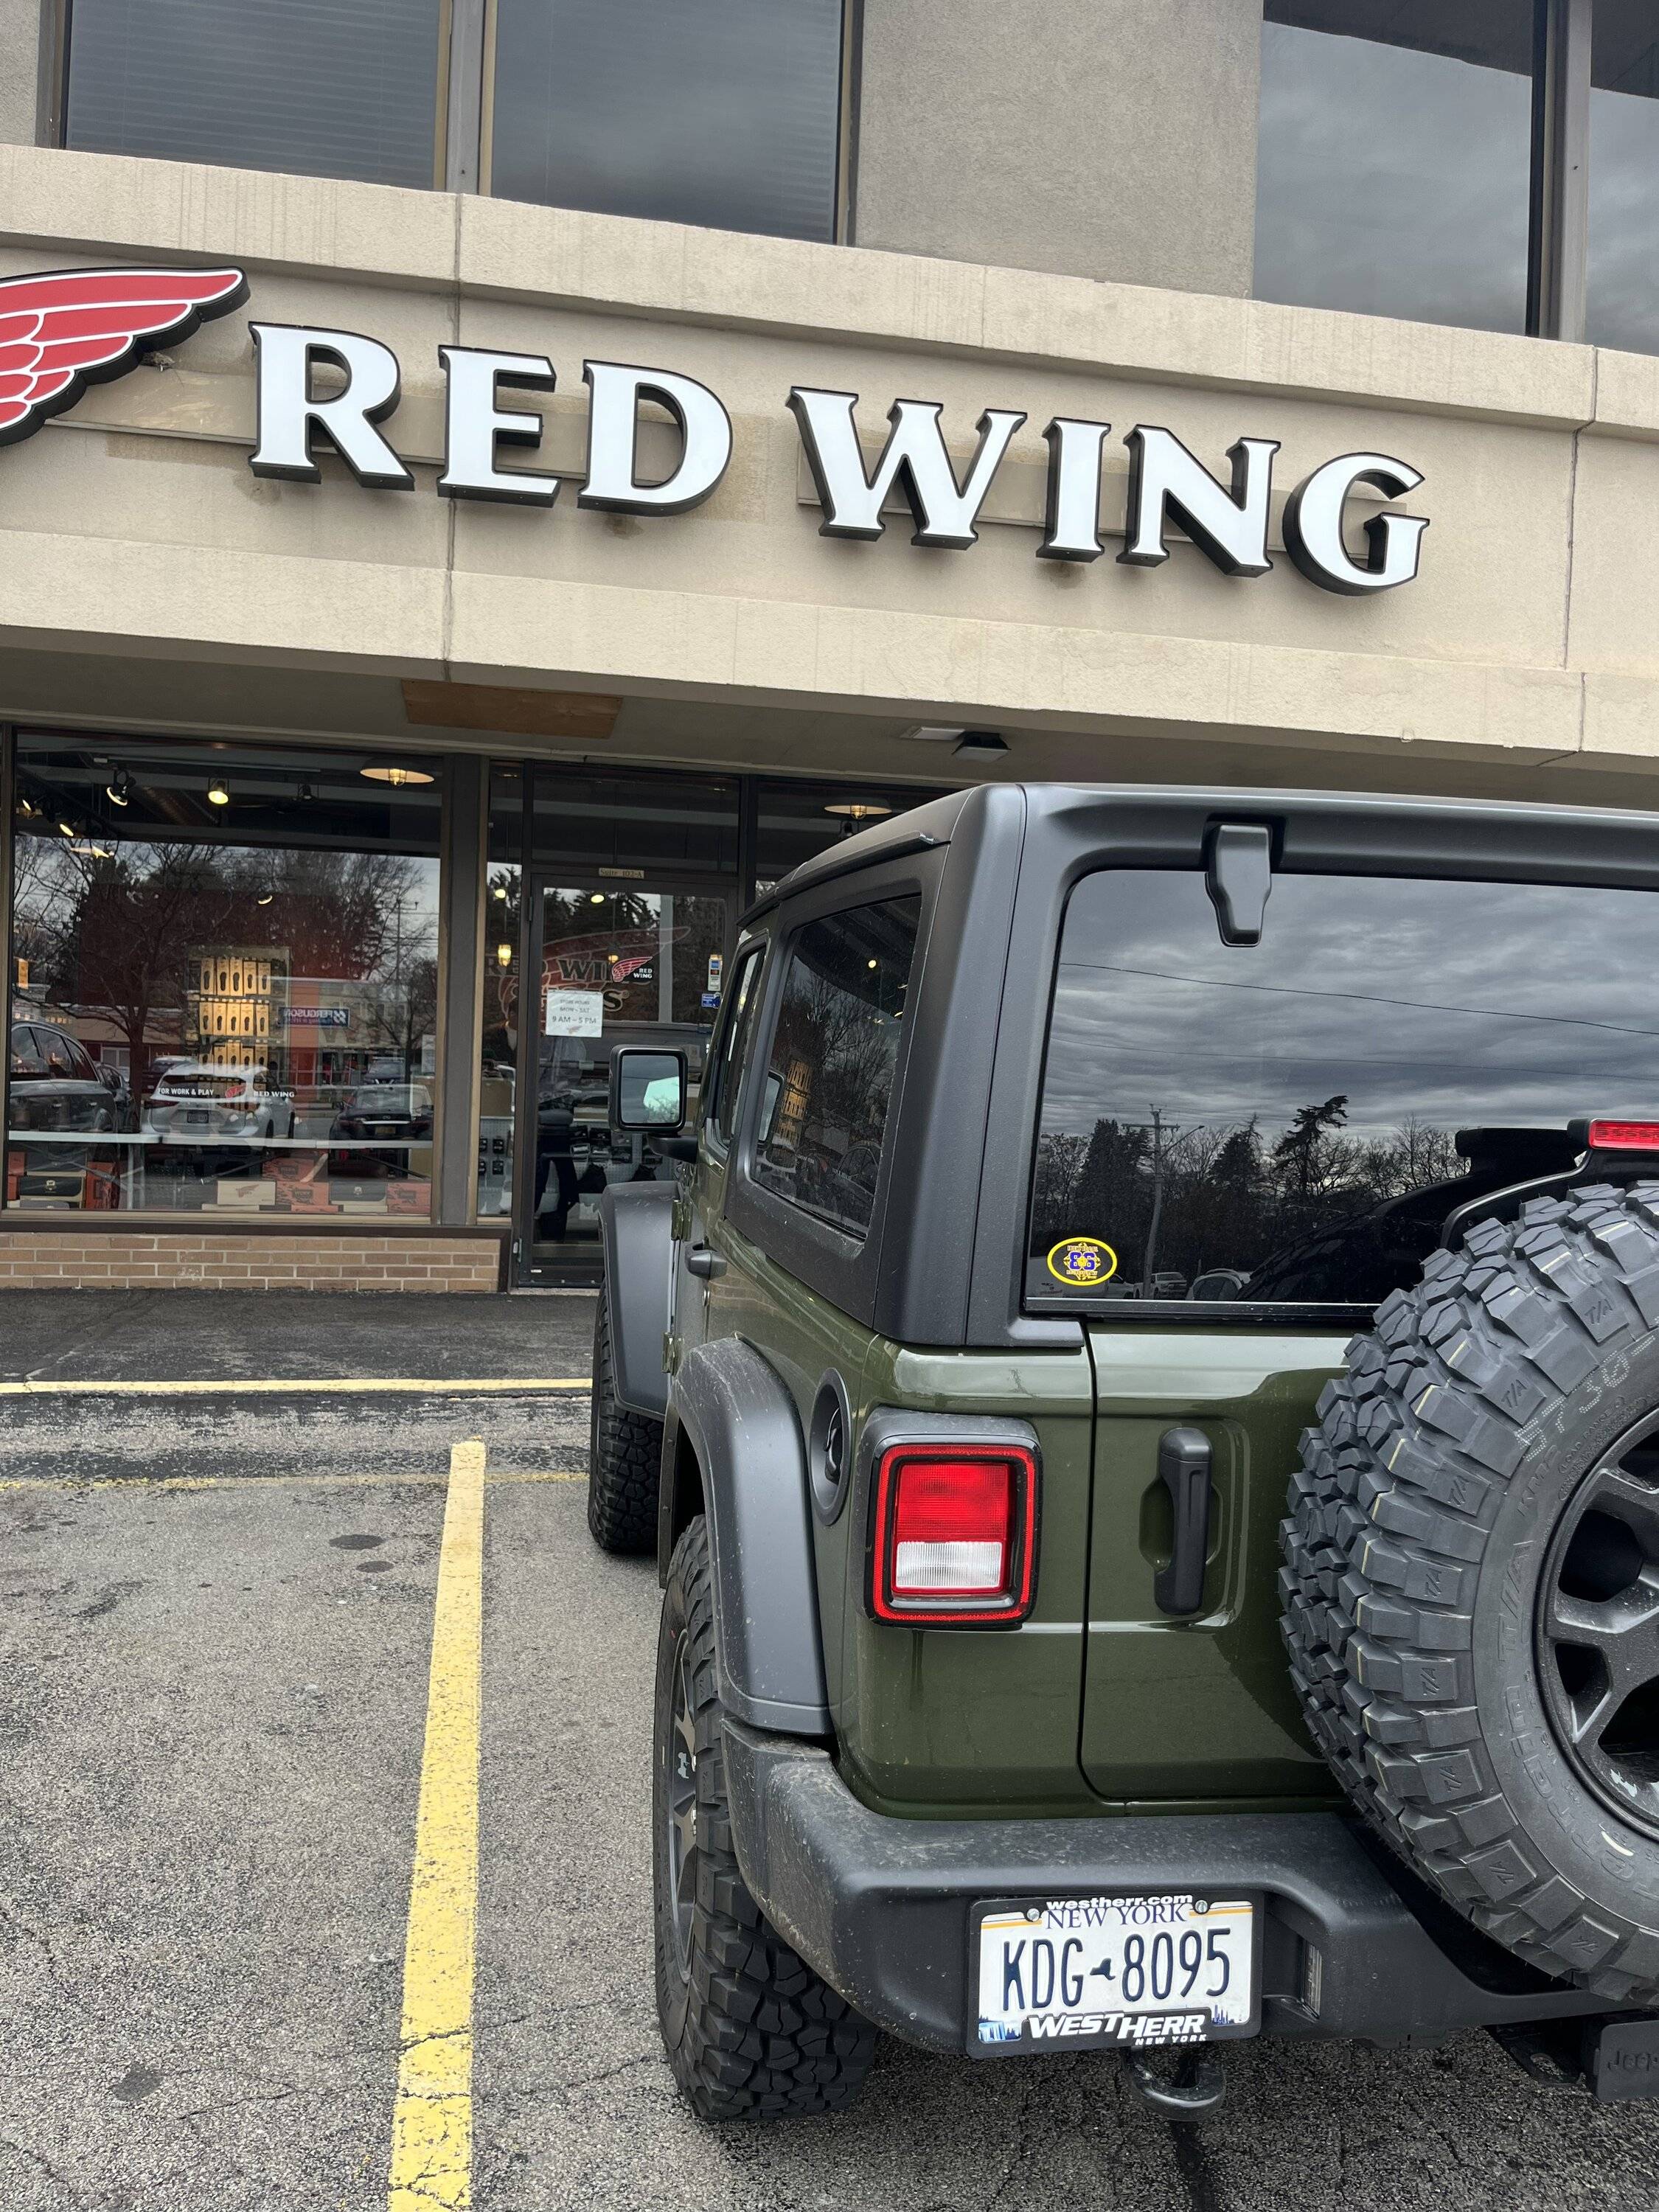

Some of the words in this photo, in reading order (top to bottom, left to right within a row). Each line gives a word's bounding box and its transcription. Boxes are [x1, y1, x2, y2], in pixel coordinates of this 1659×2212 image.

[248, 321, 733, 515] RED
[785, 386, 1430, 595] WING
[1069, 1251, 1096, 1270] 86
[1046, 1894, 1193, 1910] westherr.com
[1046, 1907, 1107, 1929] NEW
[1117, 1902, 1189, 1925] YORK
[1003, 1938, 1084, 2011] KDG
[1121, 1927, 1231, 2003] 8095
[1135, 2037, 1166, 2045] NEW
[1171, 2034, 1207, 2043] YORK
